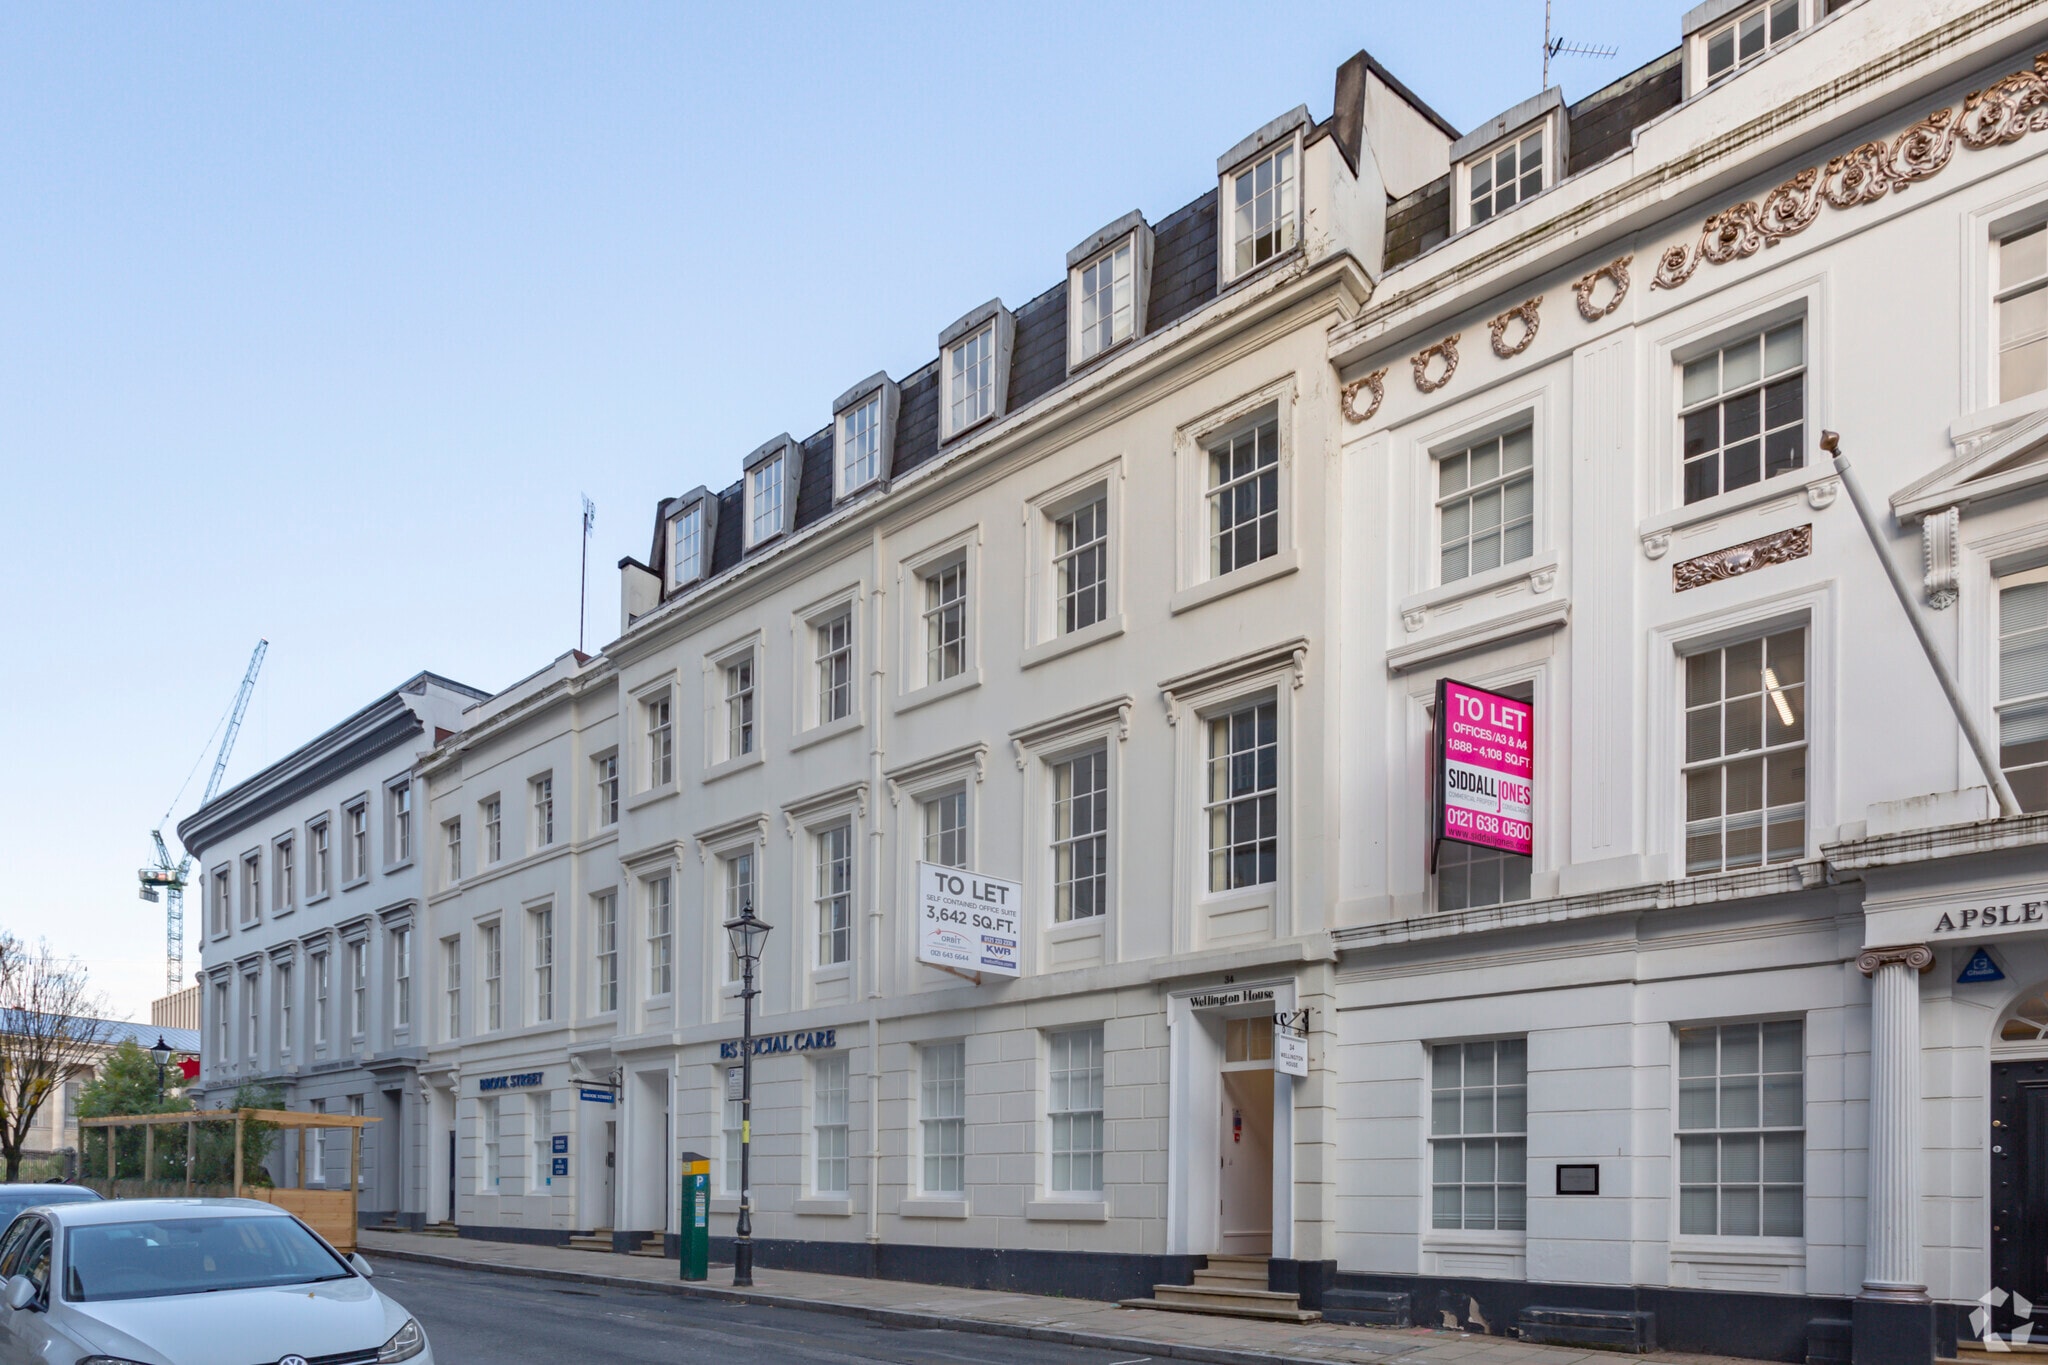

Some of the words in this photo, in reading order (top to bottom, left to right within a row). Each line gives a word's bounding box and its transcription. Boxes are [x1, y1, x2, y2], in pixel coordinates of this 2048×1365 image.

[1455, 693, 1484, 721] TO
[1490, 703, 1527, 732] LET
[1516, 739, 1528, 751] A4
[1448, 768, 1497, 798] SIDDALL
[1496, 780, 1531, 813] JONES
[1447, 808, 1473, 829] 0121
[1476, 814, 1499, 834] 638
[1502, 820, 1531, 841] 0500
[935, 872, 965, 895] TO
[972, 880, 1009, 905] LET
[926, 894, 941, 903] SELF
[943, 897, 977, 910] CONTAINED
[978, 904, 1000, 914] OFFICE
[1001, 908, 1017, 918] SUITE
[1934, 900, 2048, 931] APSLE
[926, 905, 967, 925] 3,642
[972, 914, 1017, 935] SQ.FT.
[942, 951, 954, 960] 643
[1224, 975, 1235, 984] 34
[1966, 969, 1994, 977] Chubb
[1190, 992, 1240, 1008] Wellington
[1243, 990, 1274, 1002] House
[720, 1041, 738, 1058] BS
[794, 1029, 837, 1050] CARE
[510, 1071, 544, 1088] STREET
